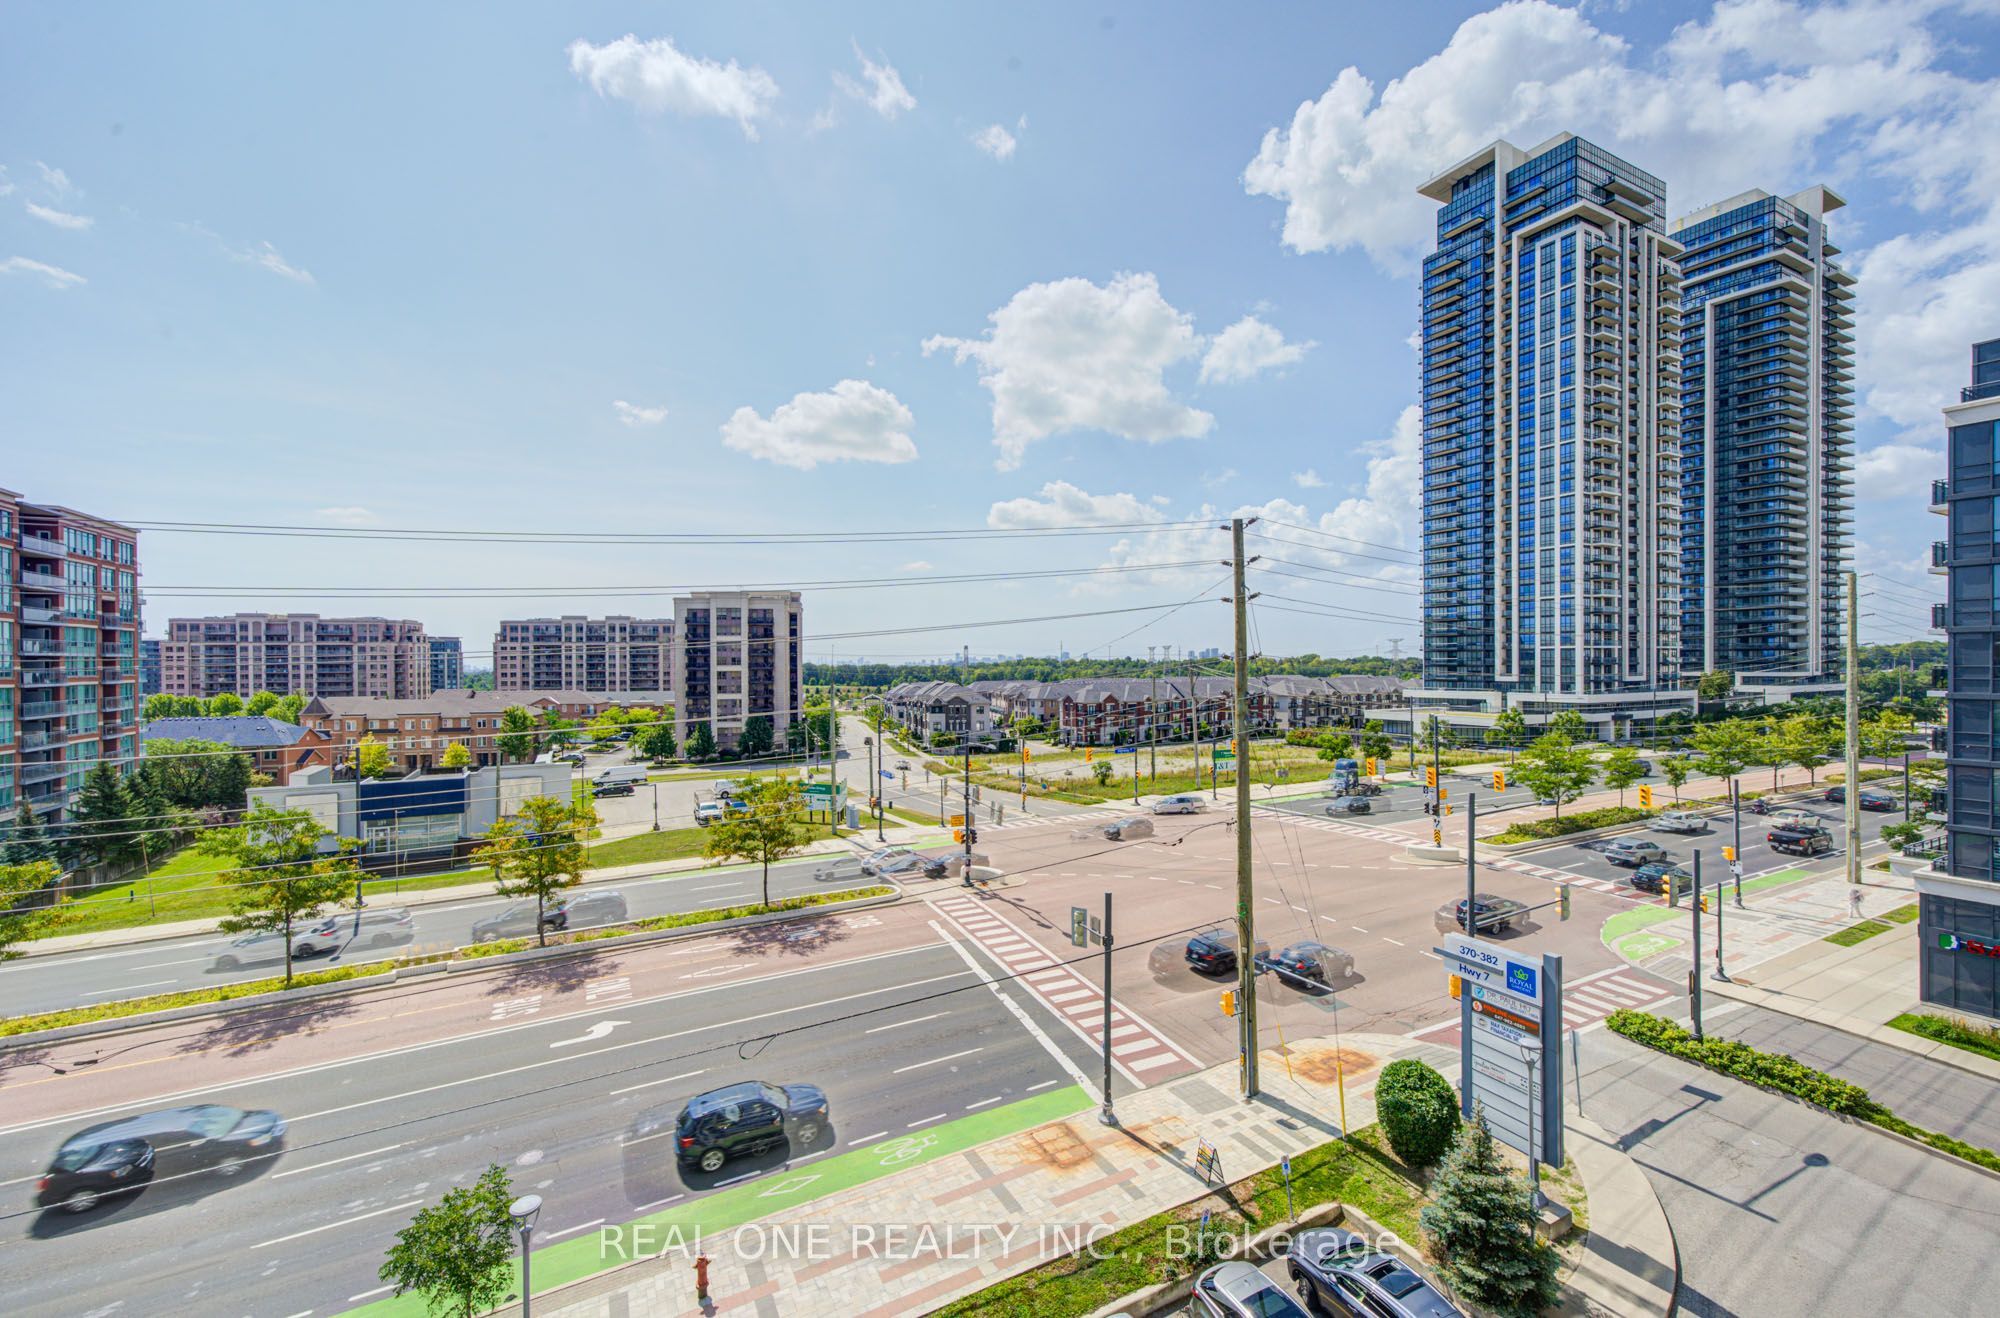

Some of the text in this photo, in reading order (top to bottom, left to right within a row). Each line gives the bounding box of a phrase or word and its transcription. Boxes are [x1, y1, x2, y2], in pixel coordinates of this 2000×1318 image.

[1459, 945, 1498, 966] 370-382
[1459, 964, 1490, 981] Hwy 7
[1509, 976, 1534, 990] ROYAL
